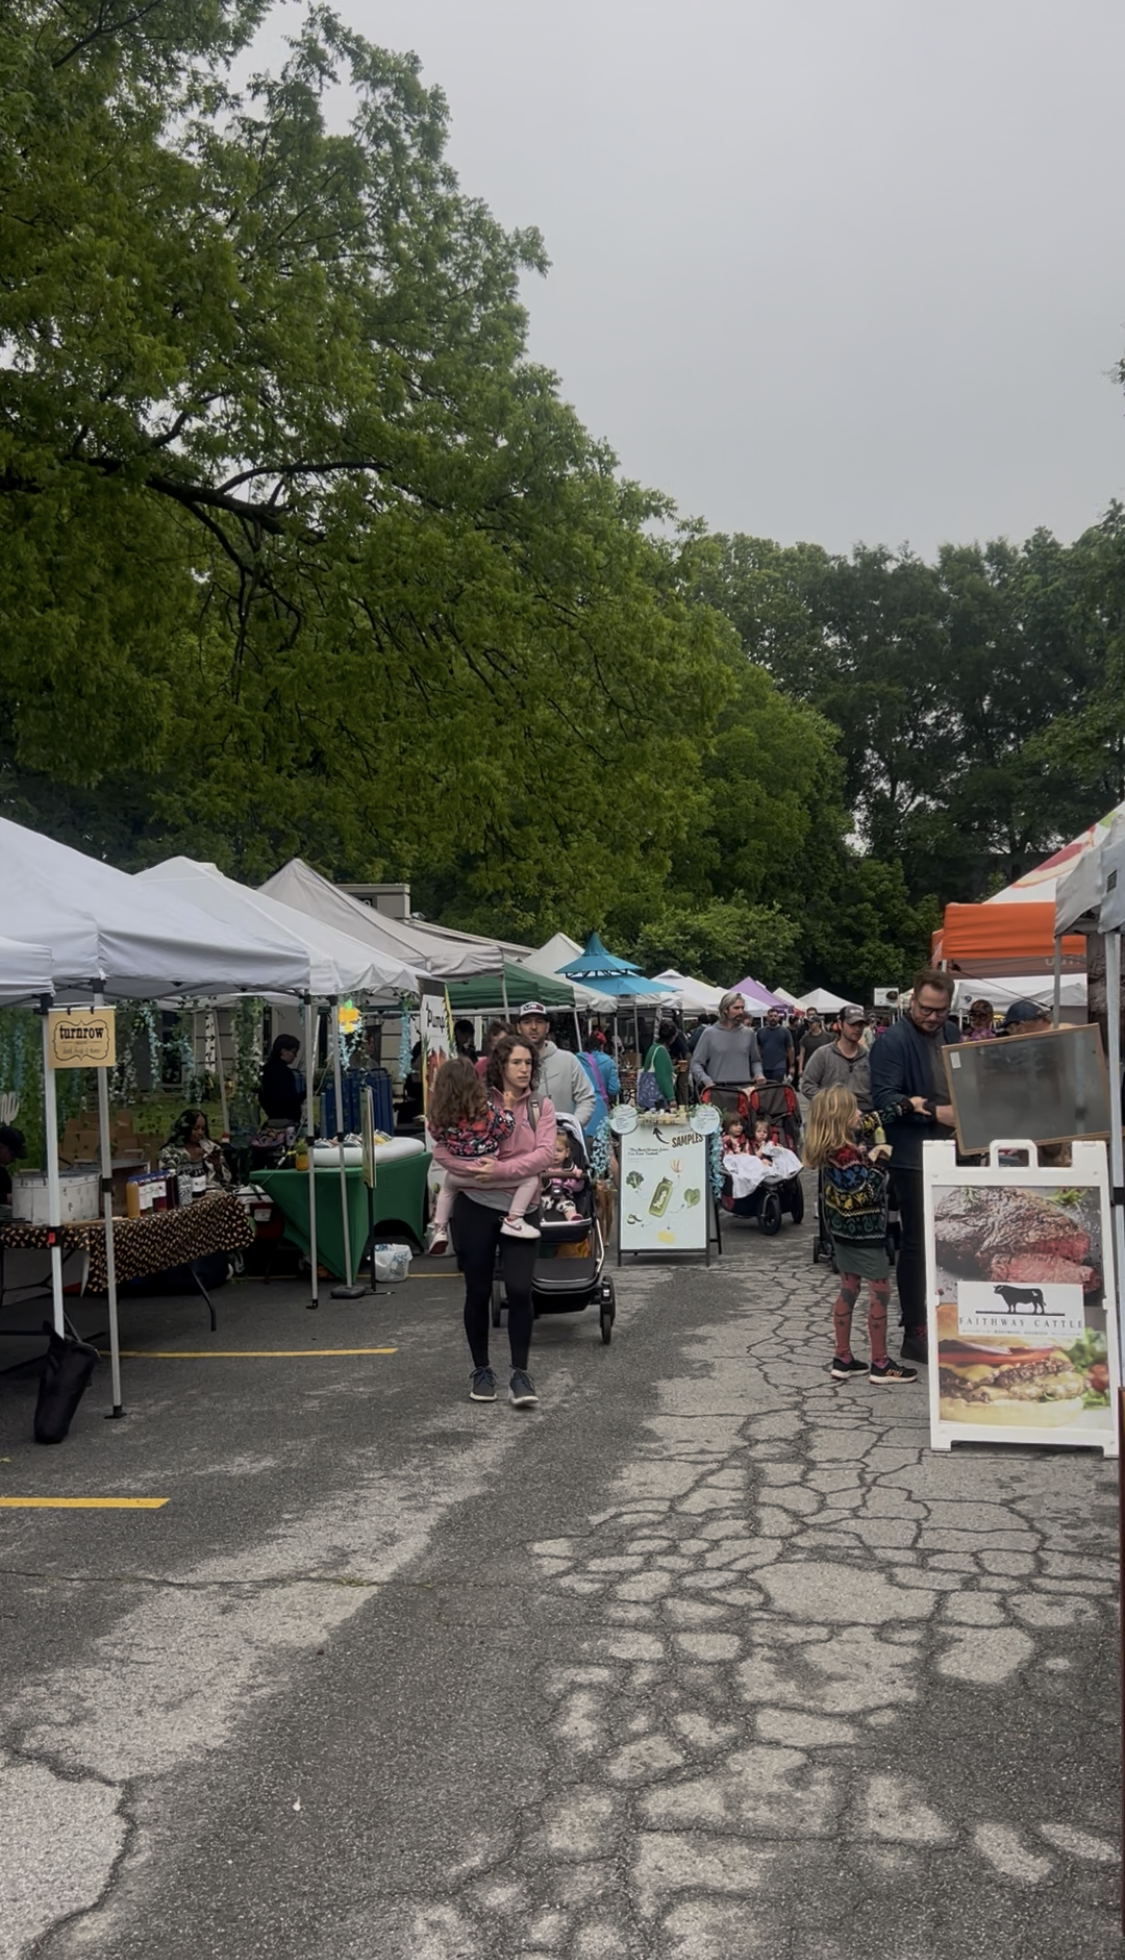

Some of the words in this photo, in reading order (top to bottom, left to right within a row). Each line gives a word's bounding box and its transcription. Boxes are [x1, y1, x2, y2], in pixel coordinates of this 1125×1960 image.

[59, 1025, 104, 1040] turnrow
[672, 1133, 703, 1148] SAMPLES
[958, 1317, 1025, 1327] FAITHWAY
[1034, 1320, 1084, 1329] CATTLE
